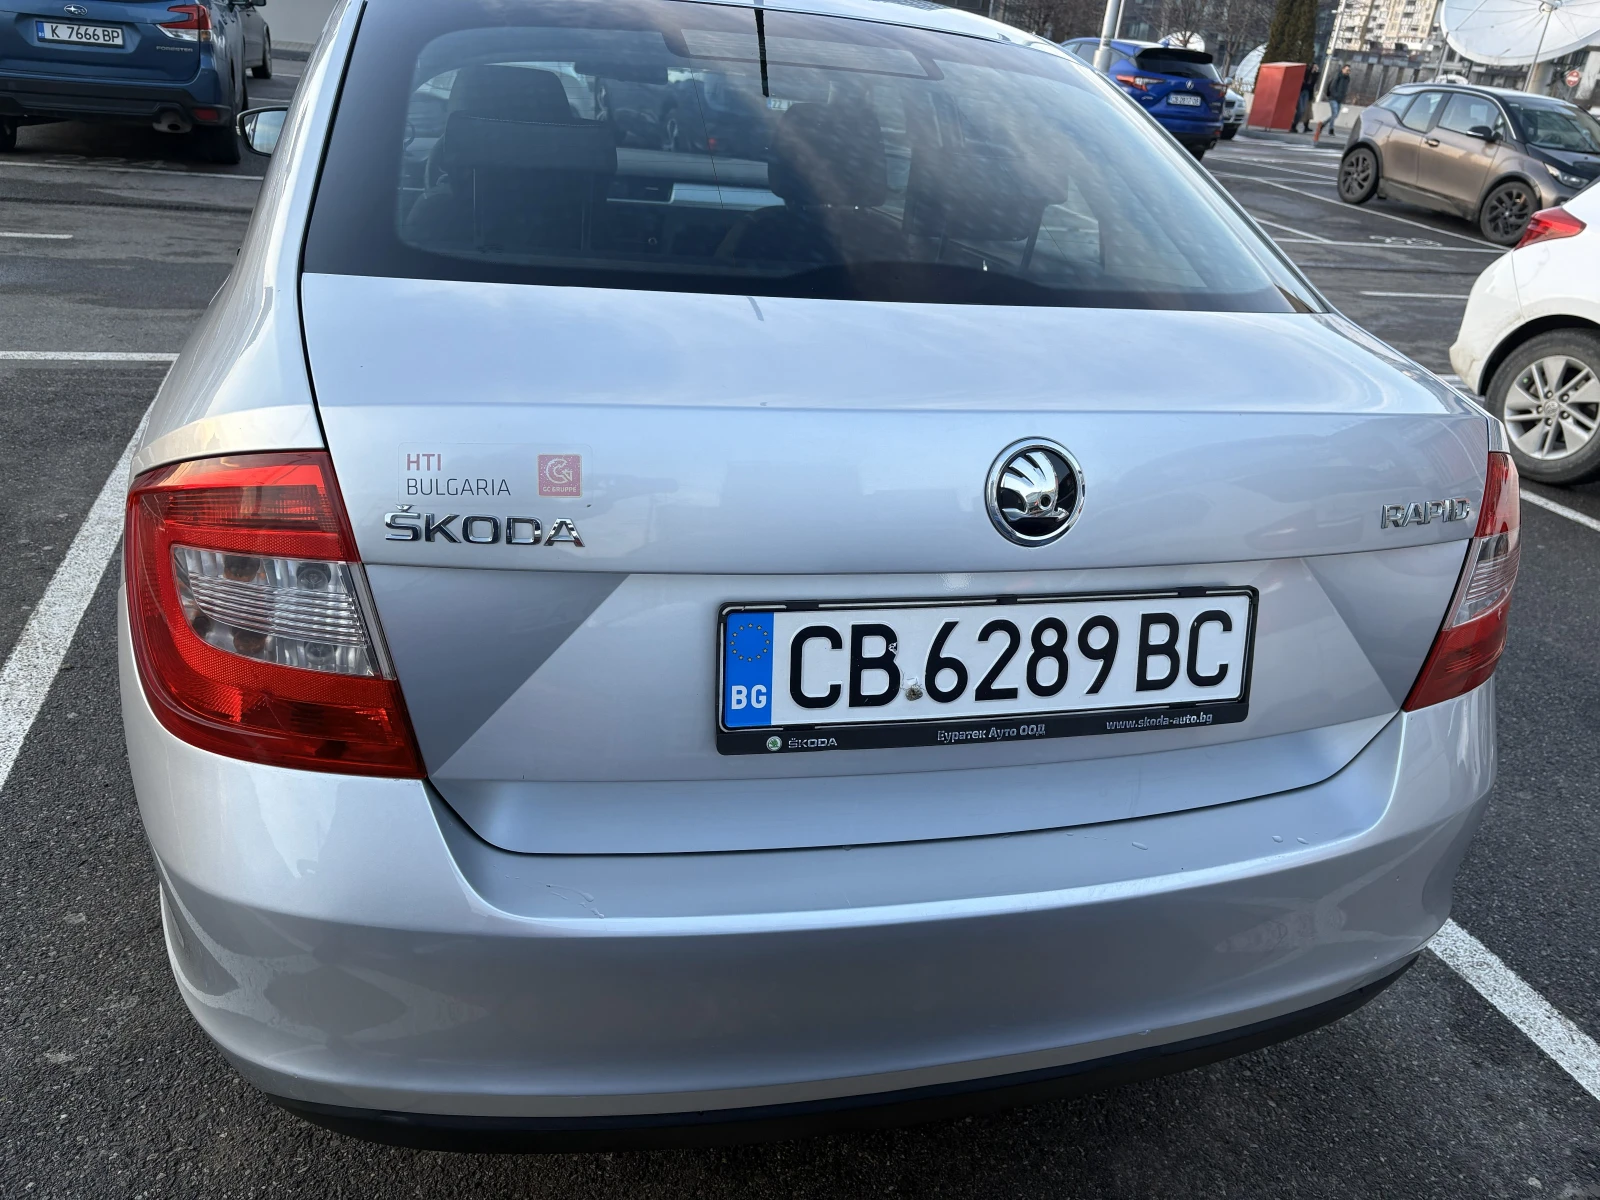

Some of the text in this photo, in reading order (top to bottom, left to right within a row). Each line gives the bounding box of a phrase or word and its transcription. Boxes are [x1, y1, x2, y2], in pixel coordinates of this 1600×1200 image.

[50, 24, 120, 42] K 7666 BP
[406, 453, 442, 471] HTI
[406, 478, 511, 496] BULGARIA
[1381, 496, 1470, 529] RAPID
[384, 504, 586, 548] ŠKODA
[788, 608, 1233, 711] CB 6289 BC
[730, 684, 768, 710] BG
[1106, 711, 1213, 730] www.skoda-auto.bg
[988, 727, 1017, 740] Ауто
